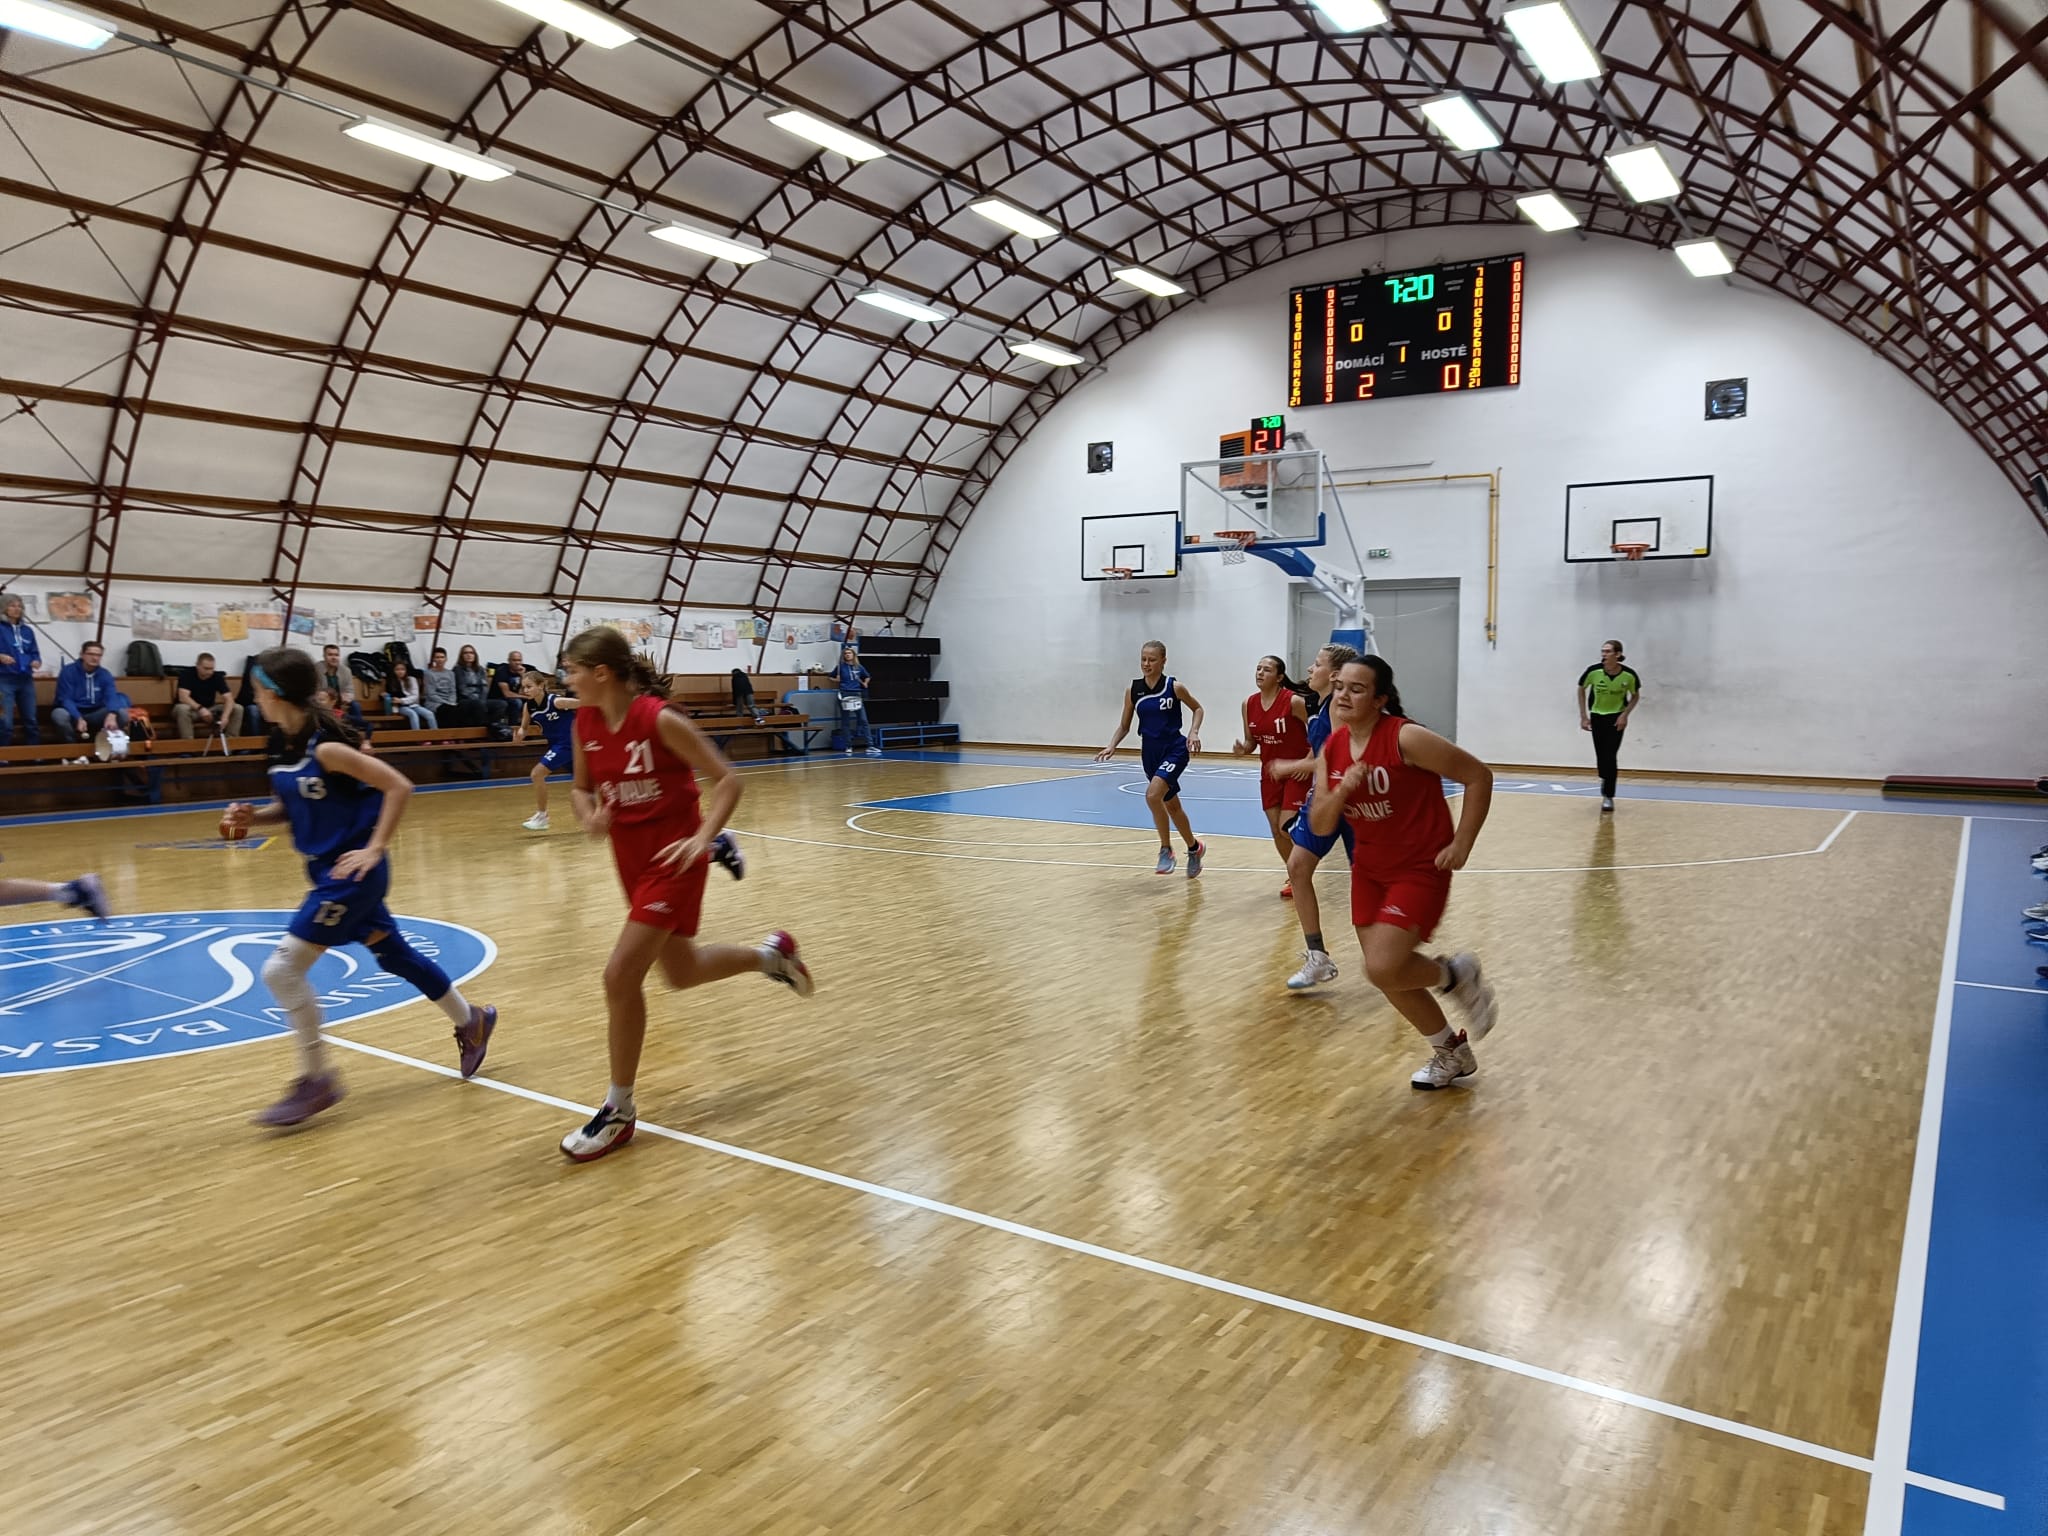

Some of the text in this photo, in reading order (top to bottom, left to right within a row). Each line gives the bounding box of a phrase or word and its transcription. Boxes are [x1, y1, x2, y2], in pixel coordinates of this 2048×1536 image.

[1514, 262, 1521, 271] 0
[1513, 272, 1521, 281] 0
[1384, 274, 1434, 304] 7:20
[1513, 283, 1520, 291] 0
[1328, 289, 1334, 298] 0
[1513, 293, 1520, 302] 0
[1512, 303, 1520, 312] 0
[1327, 309, 1334, 317] 0
[1512, 313, 1519, 322] 0
[1327, 318, 1334, 328] 0
[1438, 312, 1452, 331] 0
[1327, 328, 1334, 336] 0
[1512, 324, 1519, 332] 0
[1351, 324, 1363, 342] 0
[1327, 337, 1333, 346] 0
[1512, 334, 1519, 342] 0
[1327, 346, 1333, 355] 0
[1421, 344, 1468, 360] HOSTÉ
[1511, 344, 1518, 353] 0
[1400, 346, 1406, 363] 1
[1511, 354, 1518, 363] 0
[1327, 356, 1333, 365] 0
[1335, 353, 1385, 370] DOMÁCÍ
[1326, 365, 1333, 374] 0
[1510, 364, 1518, 373] 0
[1326, 375, 1333, 383] 0
[1444, 364, 1461, 389] 0
[1510, 374, 1517, 383] 0
[1359, 373, 1374, 398] 2
[1469, 378, 1480, 388] 21
[1326, 384, 1333, 392] 0
[1290, 397, 1301, 406] 21
[1255, 430, 1281, 451] 21
[1159, 697, 1174, 710] 20
[546, 711, 560, 720] 22
[1274, 716, 1286, 734] 11
[623, 738, 655, 775] 21
[1158, 761, 1177, 773] 20
[1366, 766, 1390, 795] 10
[296, 776, 328, 800] 13
[312, 900, 349, 927] 13
